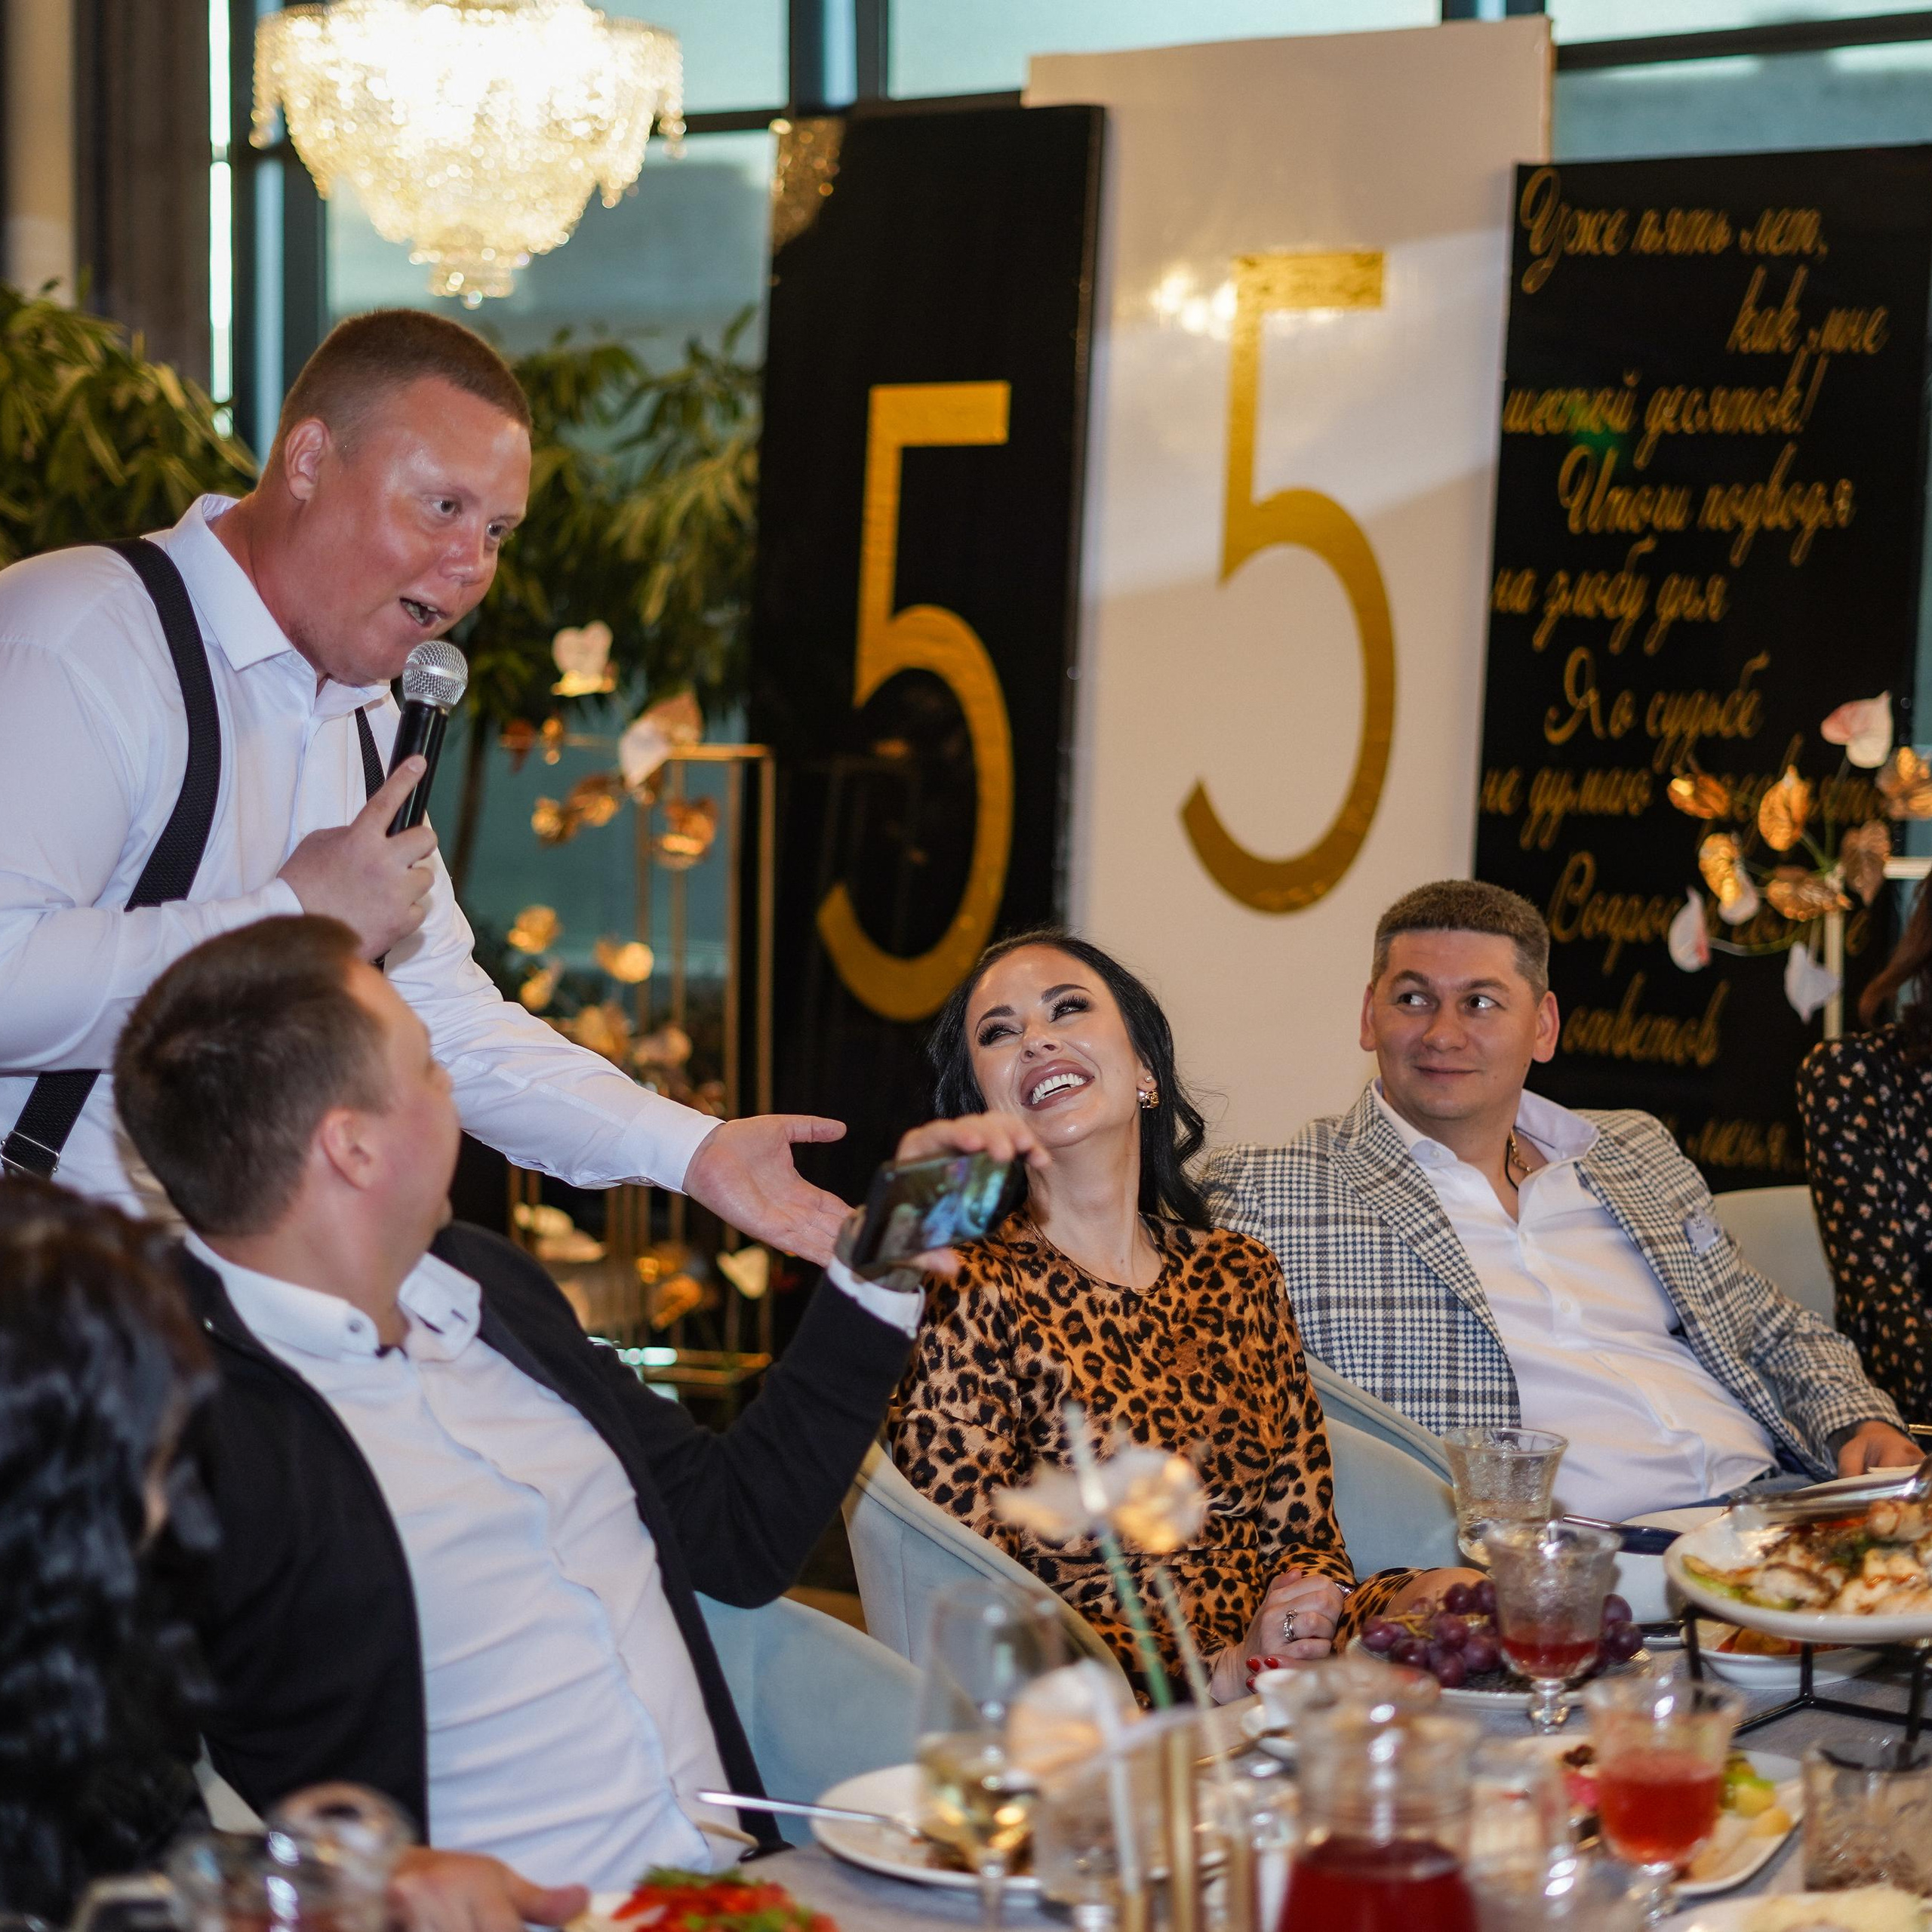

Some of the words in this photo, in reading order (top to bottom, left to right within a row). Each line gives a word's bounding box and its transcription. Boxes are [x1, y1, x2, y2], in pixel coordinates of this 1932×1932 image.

[1727, 263, 1807, 355] как
[1808, 305, 1888, 355] мне
[1180, 253, 1395, 919] 5
[1491, 567, 1539, 614] на
[817, 380, 1014, 1021] 5
[1544, 646, 1606, 746] Я
[1646, 651, 1770, 774] судьбе
